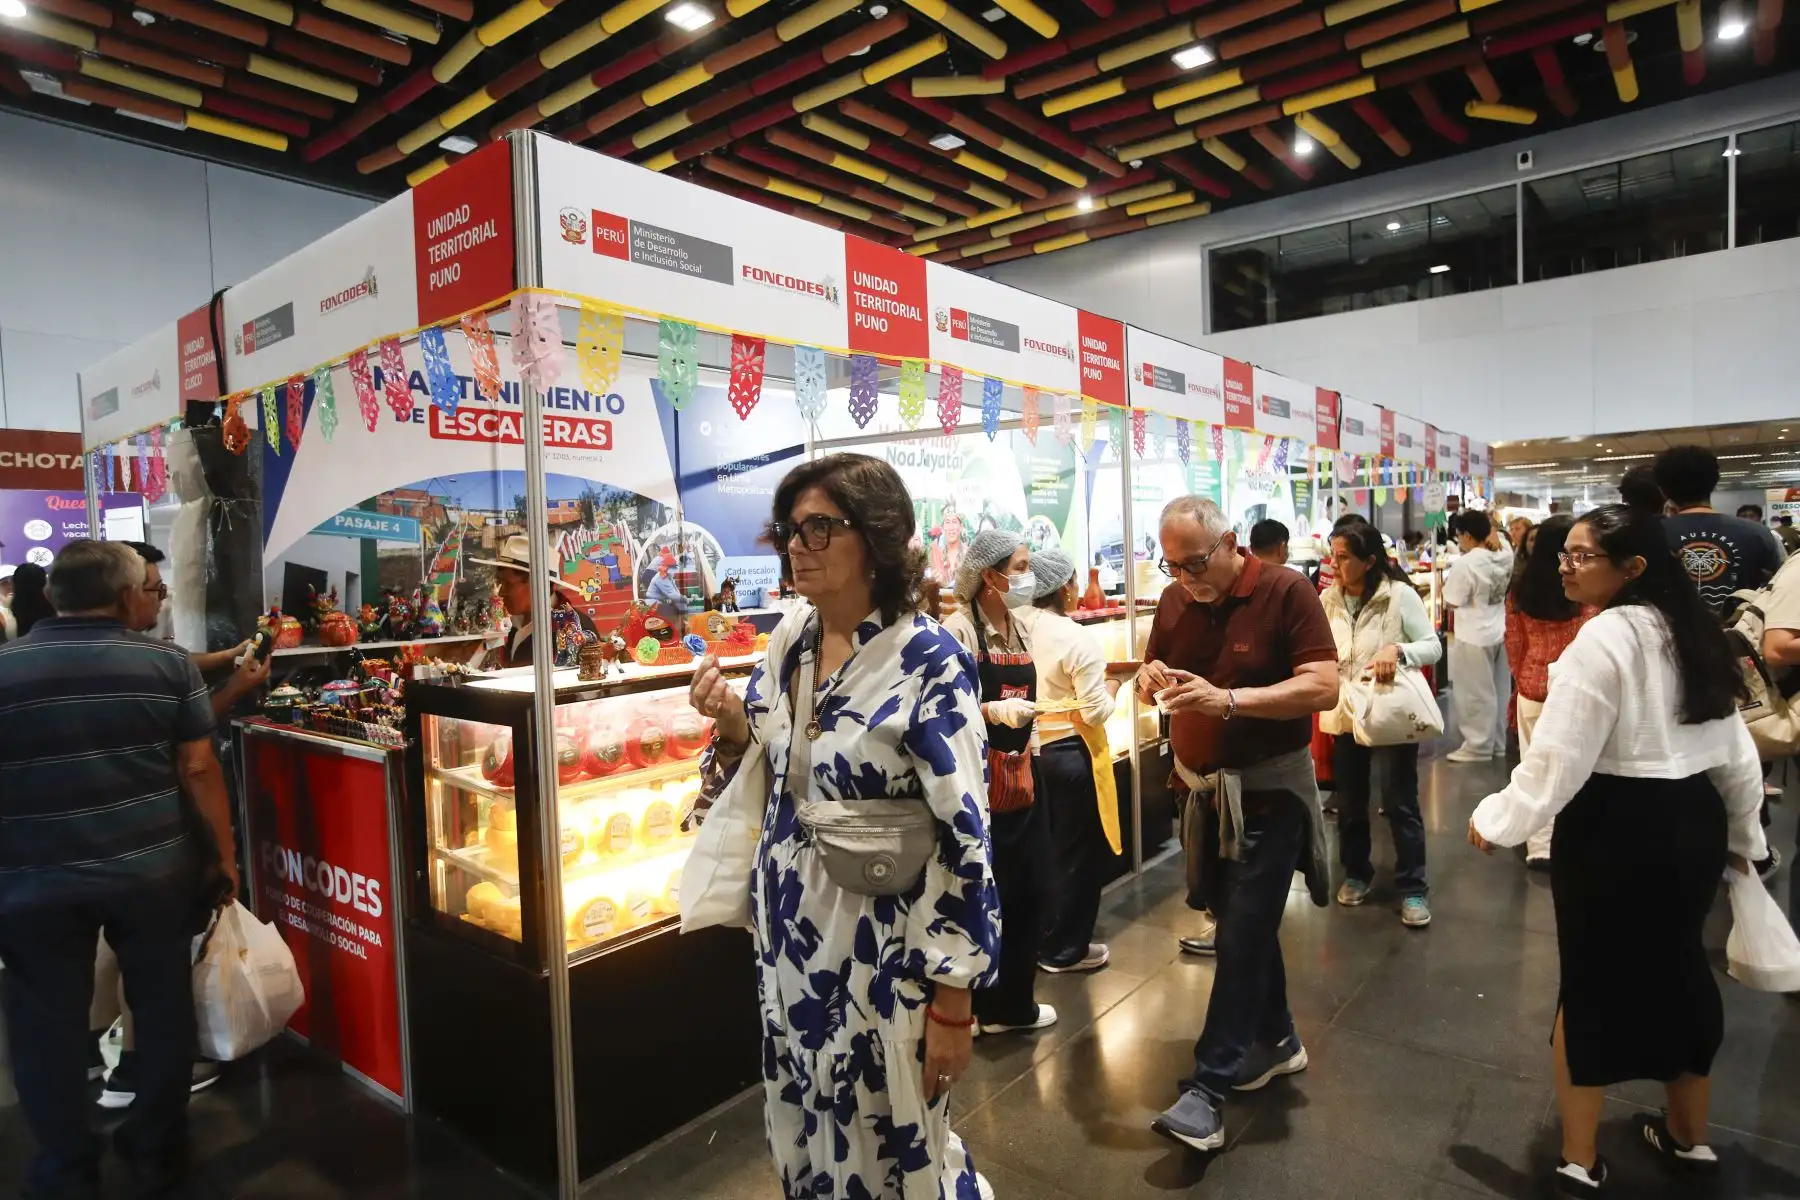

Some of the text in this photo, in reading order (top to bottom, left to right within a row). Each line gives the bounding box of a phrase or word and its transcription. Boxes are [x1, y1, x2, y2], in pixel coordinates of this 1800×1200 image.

[428, 204, 470, 239] UNIDAD
[428, 219, 498, 265] TERRITORIAL
[596, 227, 624, 244] PERÚ
[633, 225, 675, 244] Ministerio
[634, 239, 688, 259] de Desarrollo
[642, 251, 678, 268] Inclusión
[680, 261, 702, 273] Social
[430, 262, 460, 291] PUNO
[742, 265, 824, 297] FONCODES
[853, 271, 898, 295] UNIDAD
[320, 282, 367, 312] FONCODES
[854, 291, 922, 321] TERRITORIAL
[855, 312, 888, 332] PUNO
[184, 336, 204, 356] UNIDAD
[1024, 338, 1067, 357] FONCODES
[1082, 335, 1107, 352] UNIDAD
[1082, 351, 1120, 370] TERRITORIAL
[185, 373, 203, 390] CUSCO
[1083, 367, 1102, 380] PUNO
[438, 408, 607, 446] ESCAERAS
[886, 446, 915, 466] Noa
[335, 515, 400, 532] PASAJE 4
[1680, 531, 1742, 567] AUSTRALIA
[261, 840, 383, 918] FONCODES
[291, 895, 301, 910] DE
[301, 900, 357, 935] COOPERACIÓN
[358, 926, 382, 947] PARA
[338, 937, 368, 960] SOCIAL
